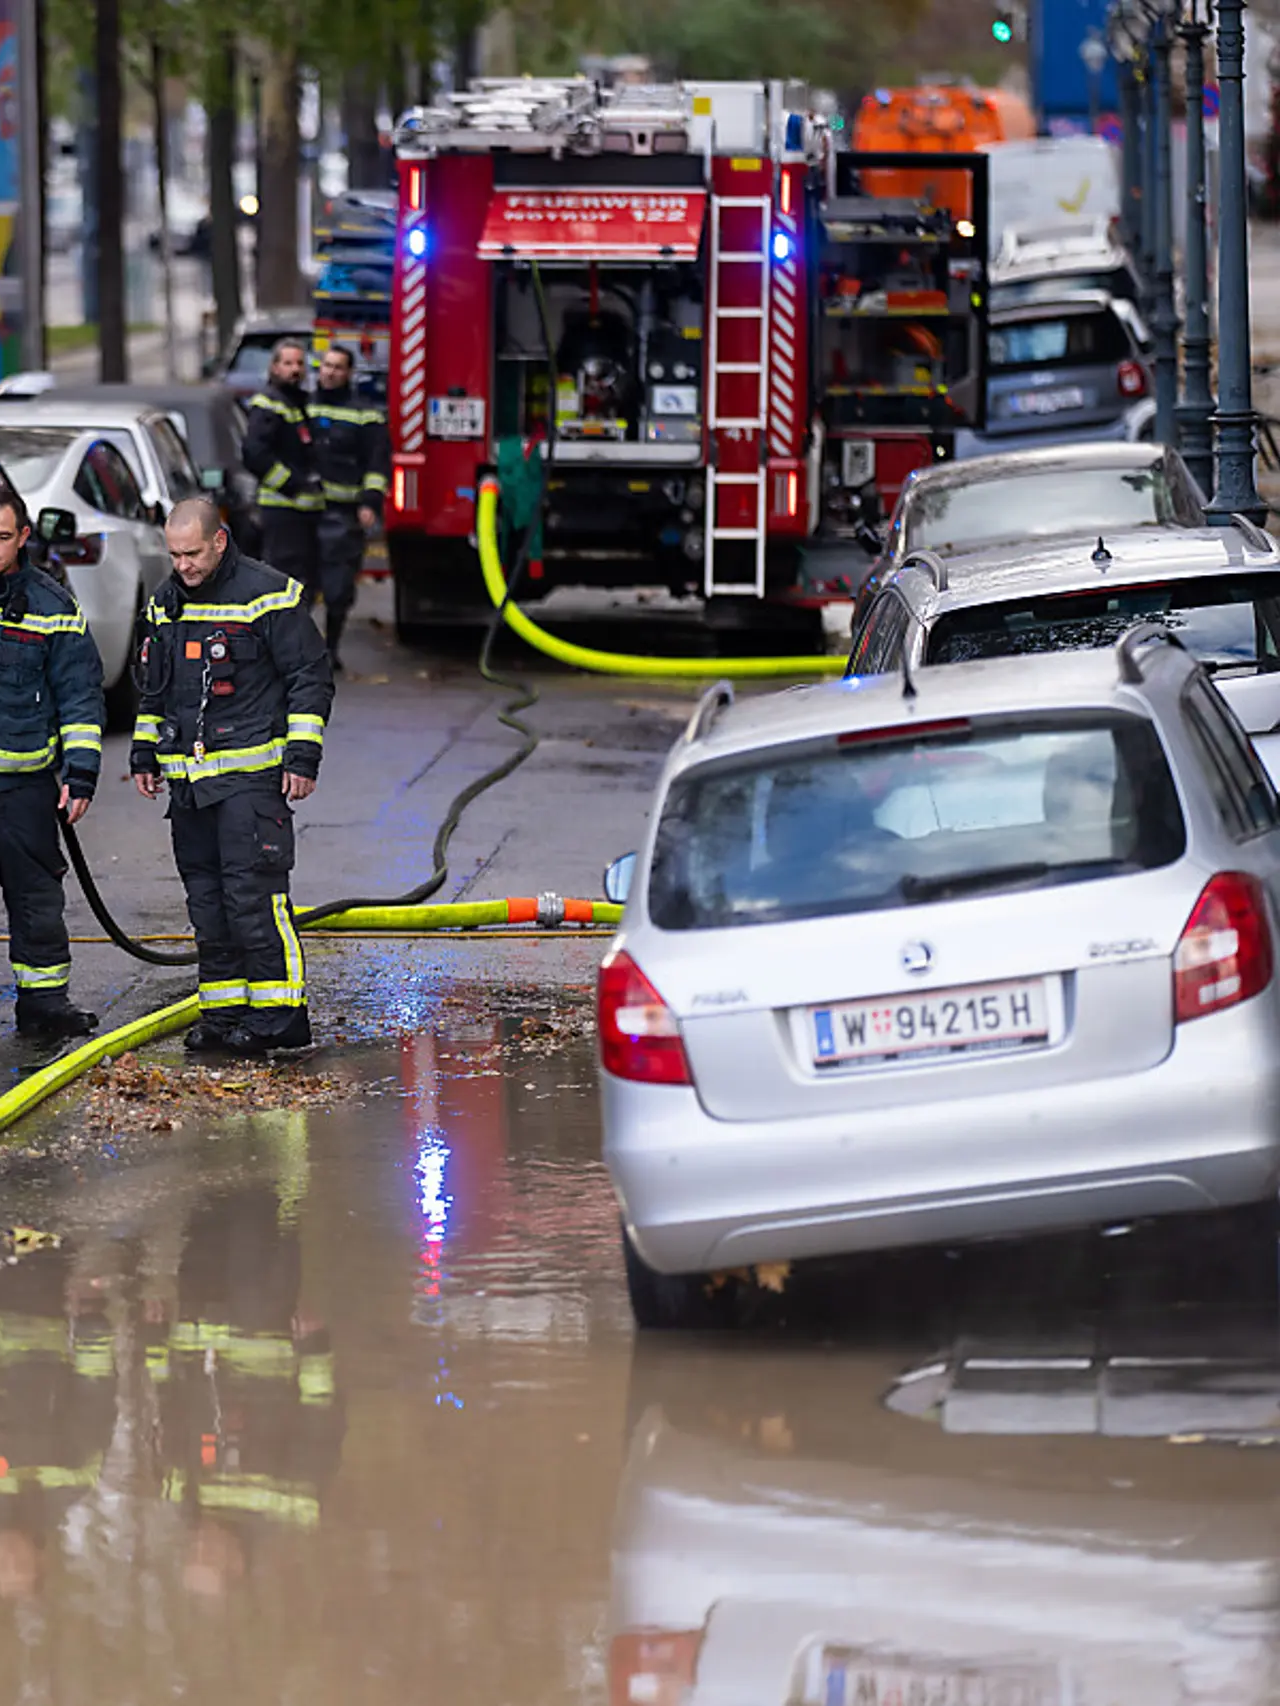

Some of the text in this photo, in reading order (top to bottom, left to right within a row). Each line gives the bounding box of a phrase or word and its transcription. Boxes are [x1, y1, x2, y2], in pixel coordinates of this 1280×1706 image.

[507, 195, 688, 209] FEUERWEHR
[631, 210, 687, 222] 122
[842, 992, 1032, 1046] W 94215 H
